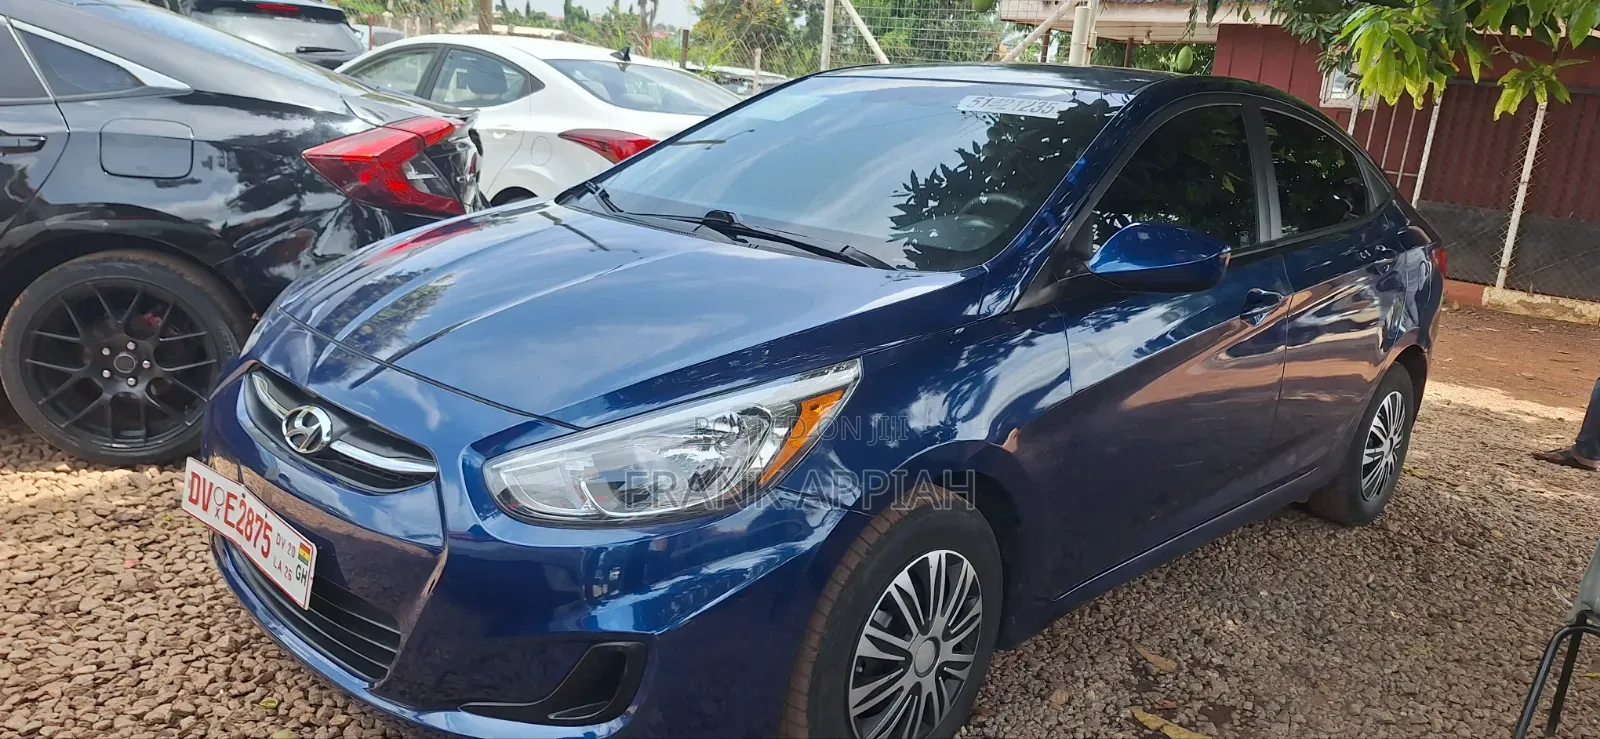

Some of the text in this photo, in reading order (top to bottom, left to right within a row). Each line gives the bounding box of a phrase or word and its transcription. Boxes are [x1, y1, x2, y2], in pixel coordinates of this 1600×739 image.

[188, 471, 273, 559] DV E2875
[275, 533, 296, 558] DV 20
[273, 556, 282, 572] LA
[295, 564, 308, 586] GH
